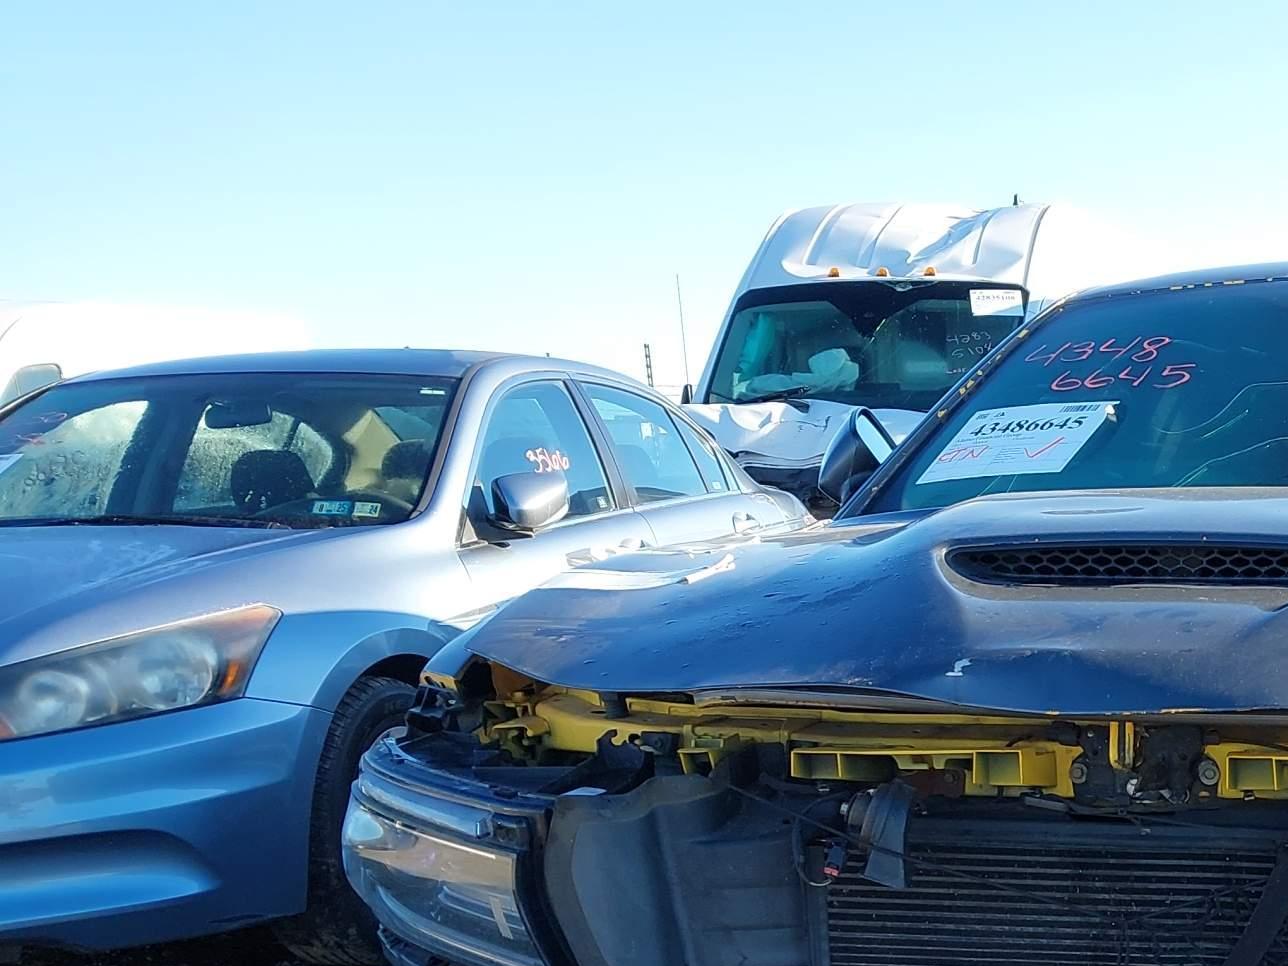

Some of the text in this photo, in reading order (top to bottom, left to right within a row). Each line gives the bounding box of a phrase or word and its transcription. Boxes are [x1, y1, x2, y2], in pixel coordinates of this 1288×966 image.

[1024, 336, 1172, 367] 4348
[1050, 363, 1196, 391] 6645
[969, 414, 1089, 437] 43486645
